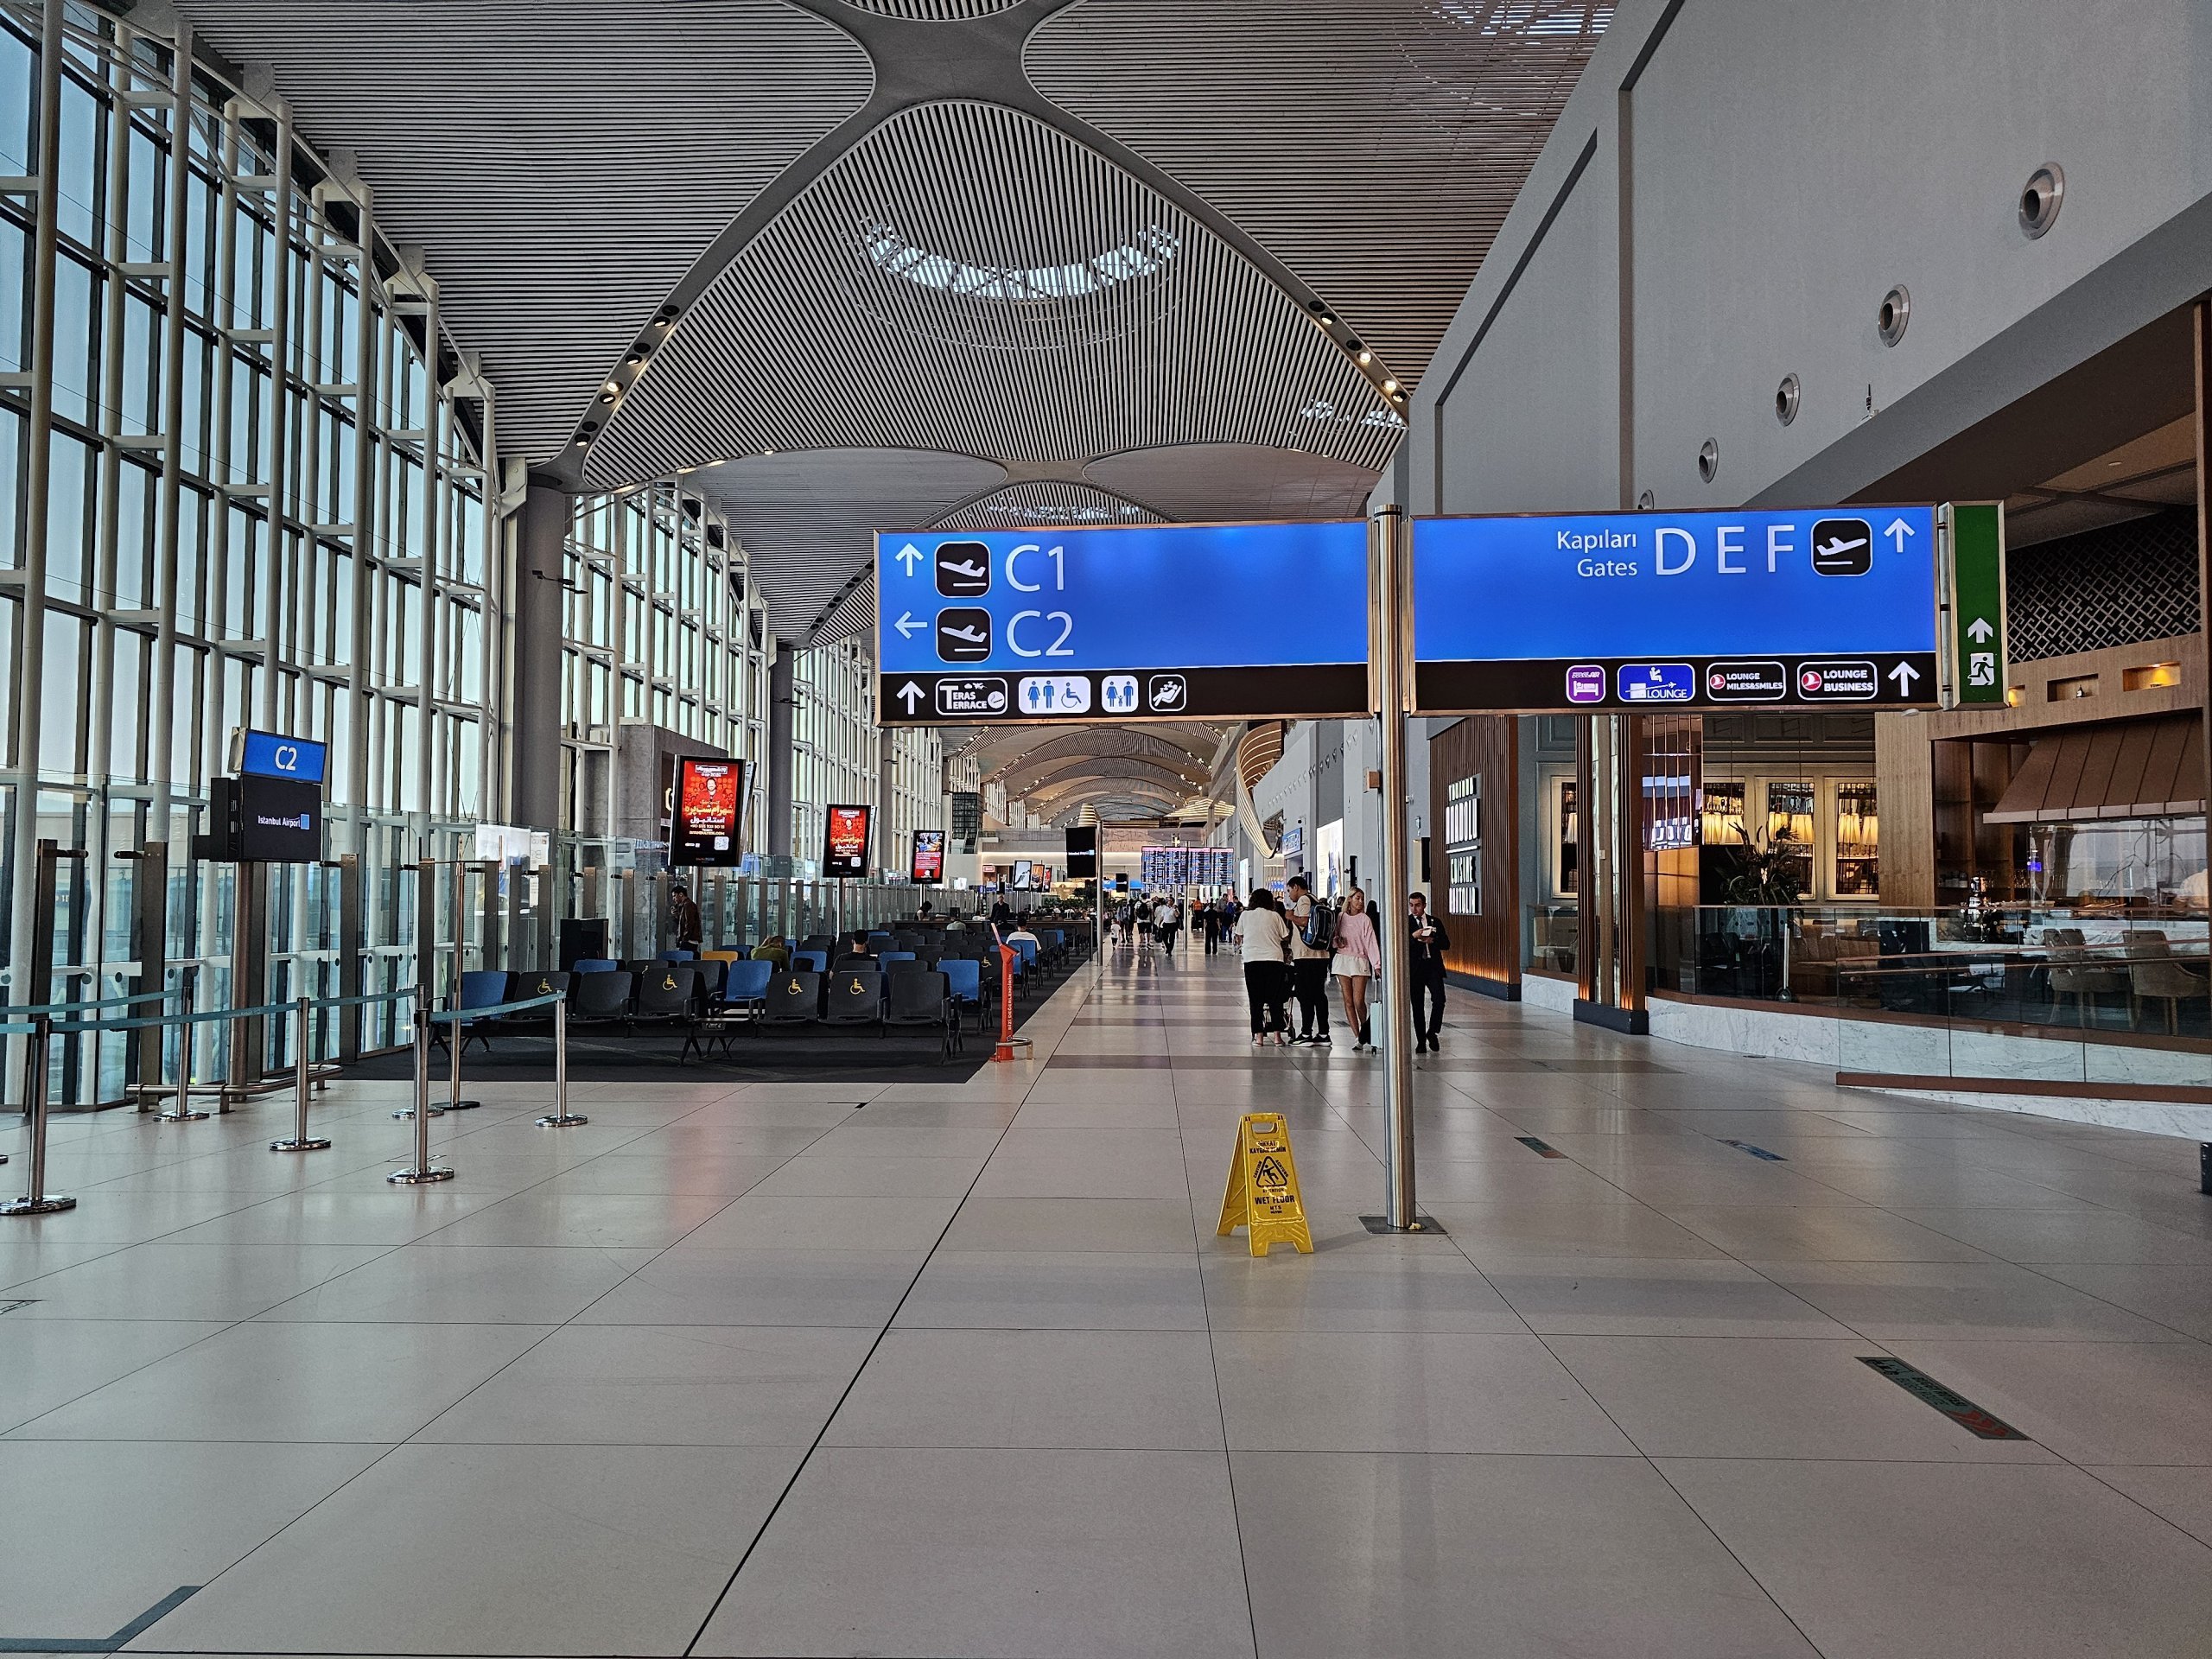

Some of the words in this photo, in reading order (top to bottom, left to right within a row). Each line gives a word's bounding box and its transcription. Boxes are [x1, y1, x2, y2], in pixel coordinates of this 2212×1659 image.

[1557, 529, 1637, 554] Kapıları
[1655, 527, 1696, 575] D
[1717, 526, 1746, 574] E
[1767, 524, 1795, 573] F
[1005, 544, 1064, 592] C1
[1577, 558, 1637, 577] Gates
[1007, 610, 1074, 657] C2
[1726, 672, 1760, 681] LOUNGE
[1823, 670, 1868, 679] LOUNGE
[1647, 689, 1688, 699] LOUNGE
[1726, 682, 1783, 690] MILES&SMILES
[1823, 682, 1874, 692] BUSINESS
[275, 745, 297, 771] C2
[257, 815, 281, 826] Istanbul
[282, 817, 301, 829] Airport
[1450, 855, 1473, 885] CUISINE
[1255, 1196, 1270, 1205] WET
[1272, 1194, 1295, 1204] FLOOR
